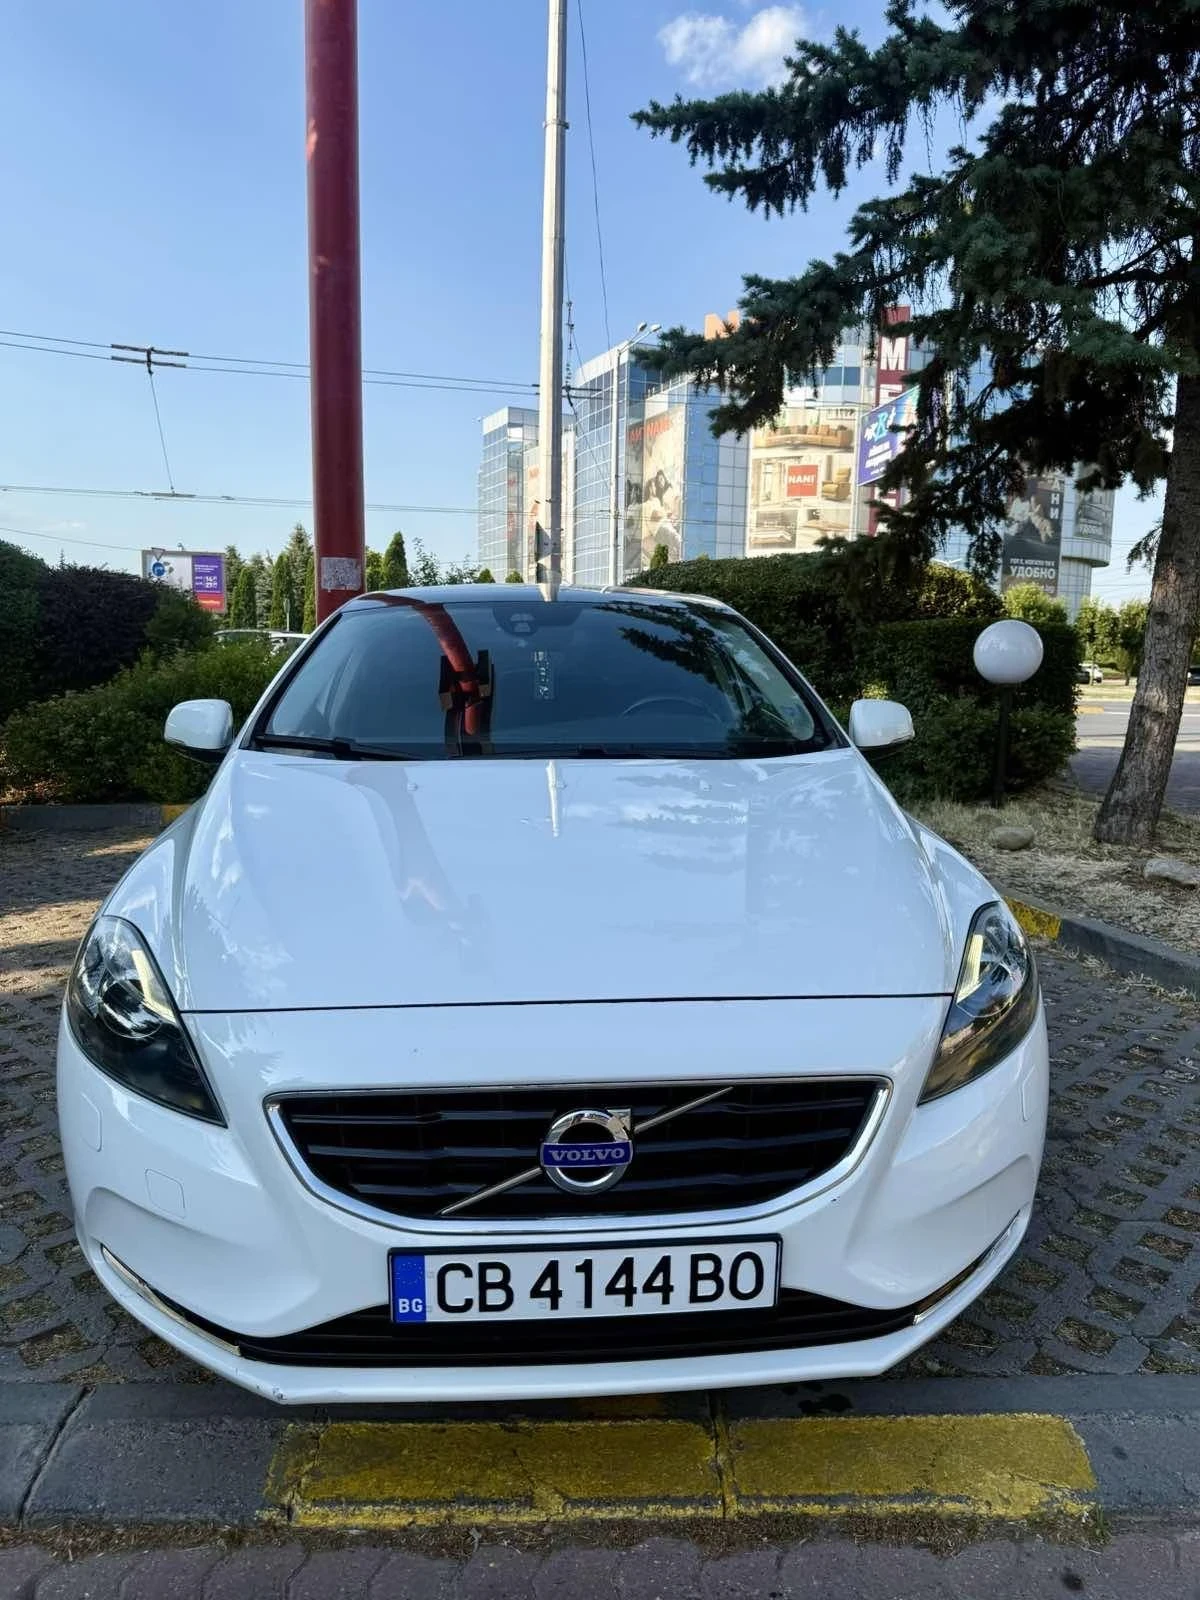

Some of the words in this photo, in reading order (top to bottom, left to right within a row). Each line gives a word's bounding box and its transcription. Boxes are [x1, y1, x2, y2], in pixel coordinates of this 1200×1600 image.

[1010, 565, 1056, 580] УДОБНО
[548, 1147, 625, 1162] VOLVO
[435, 1261, 514, 1314] CB
[529, 1254, 674, 1311] 4144
[398, 1298, 423, 1314] BG
